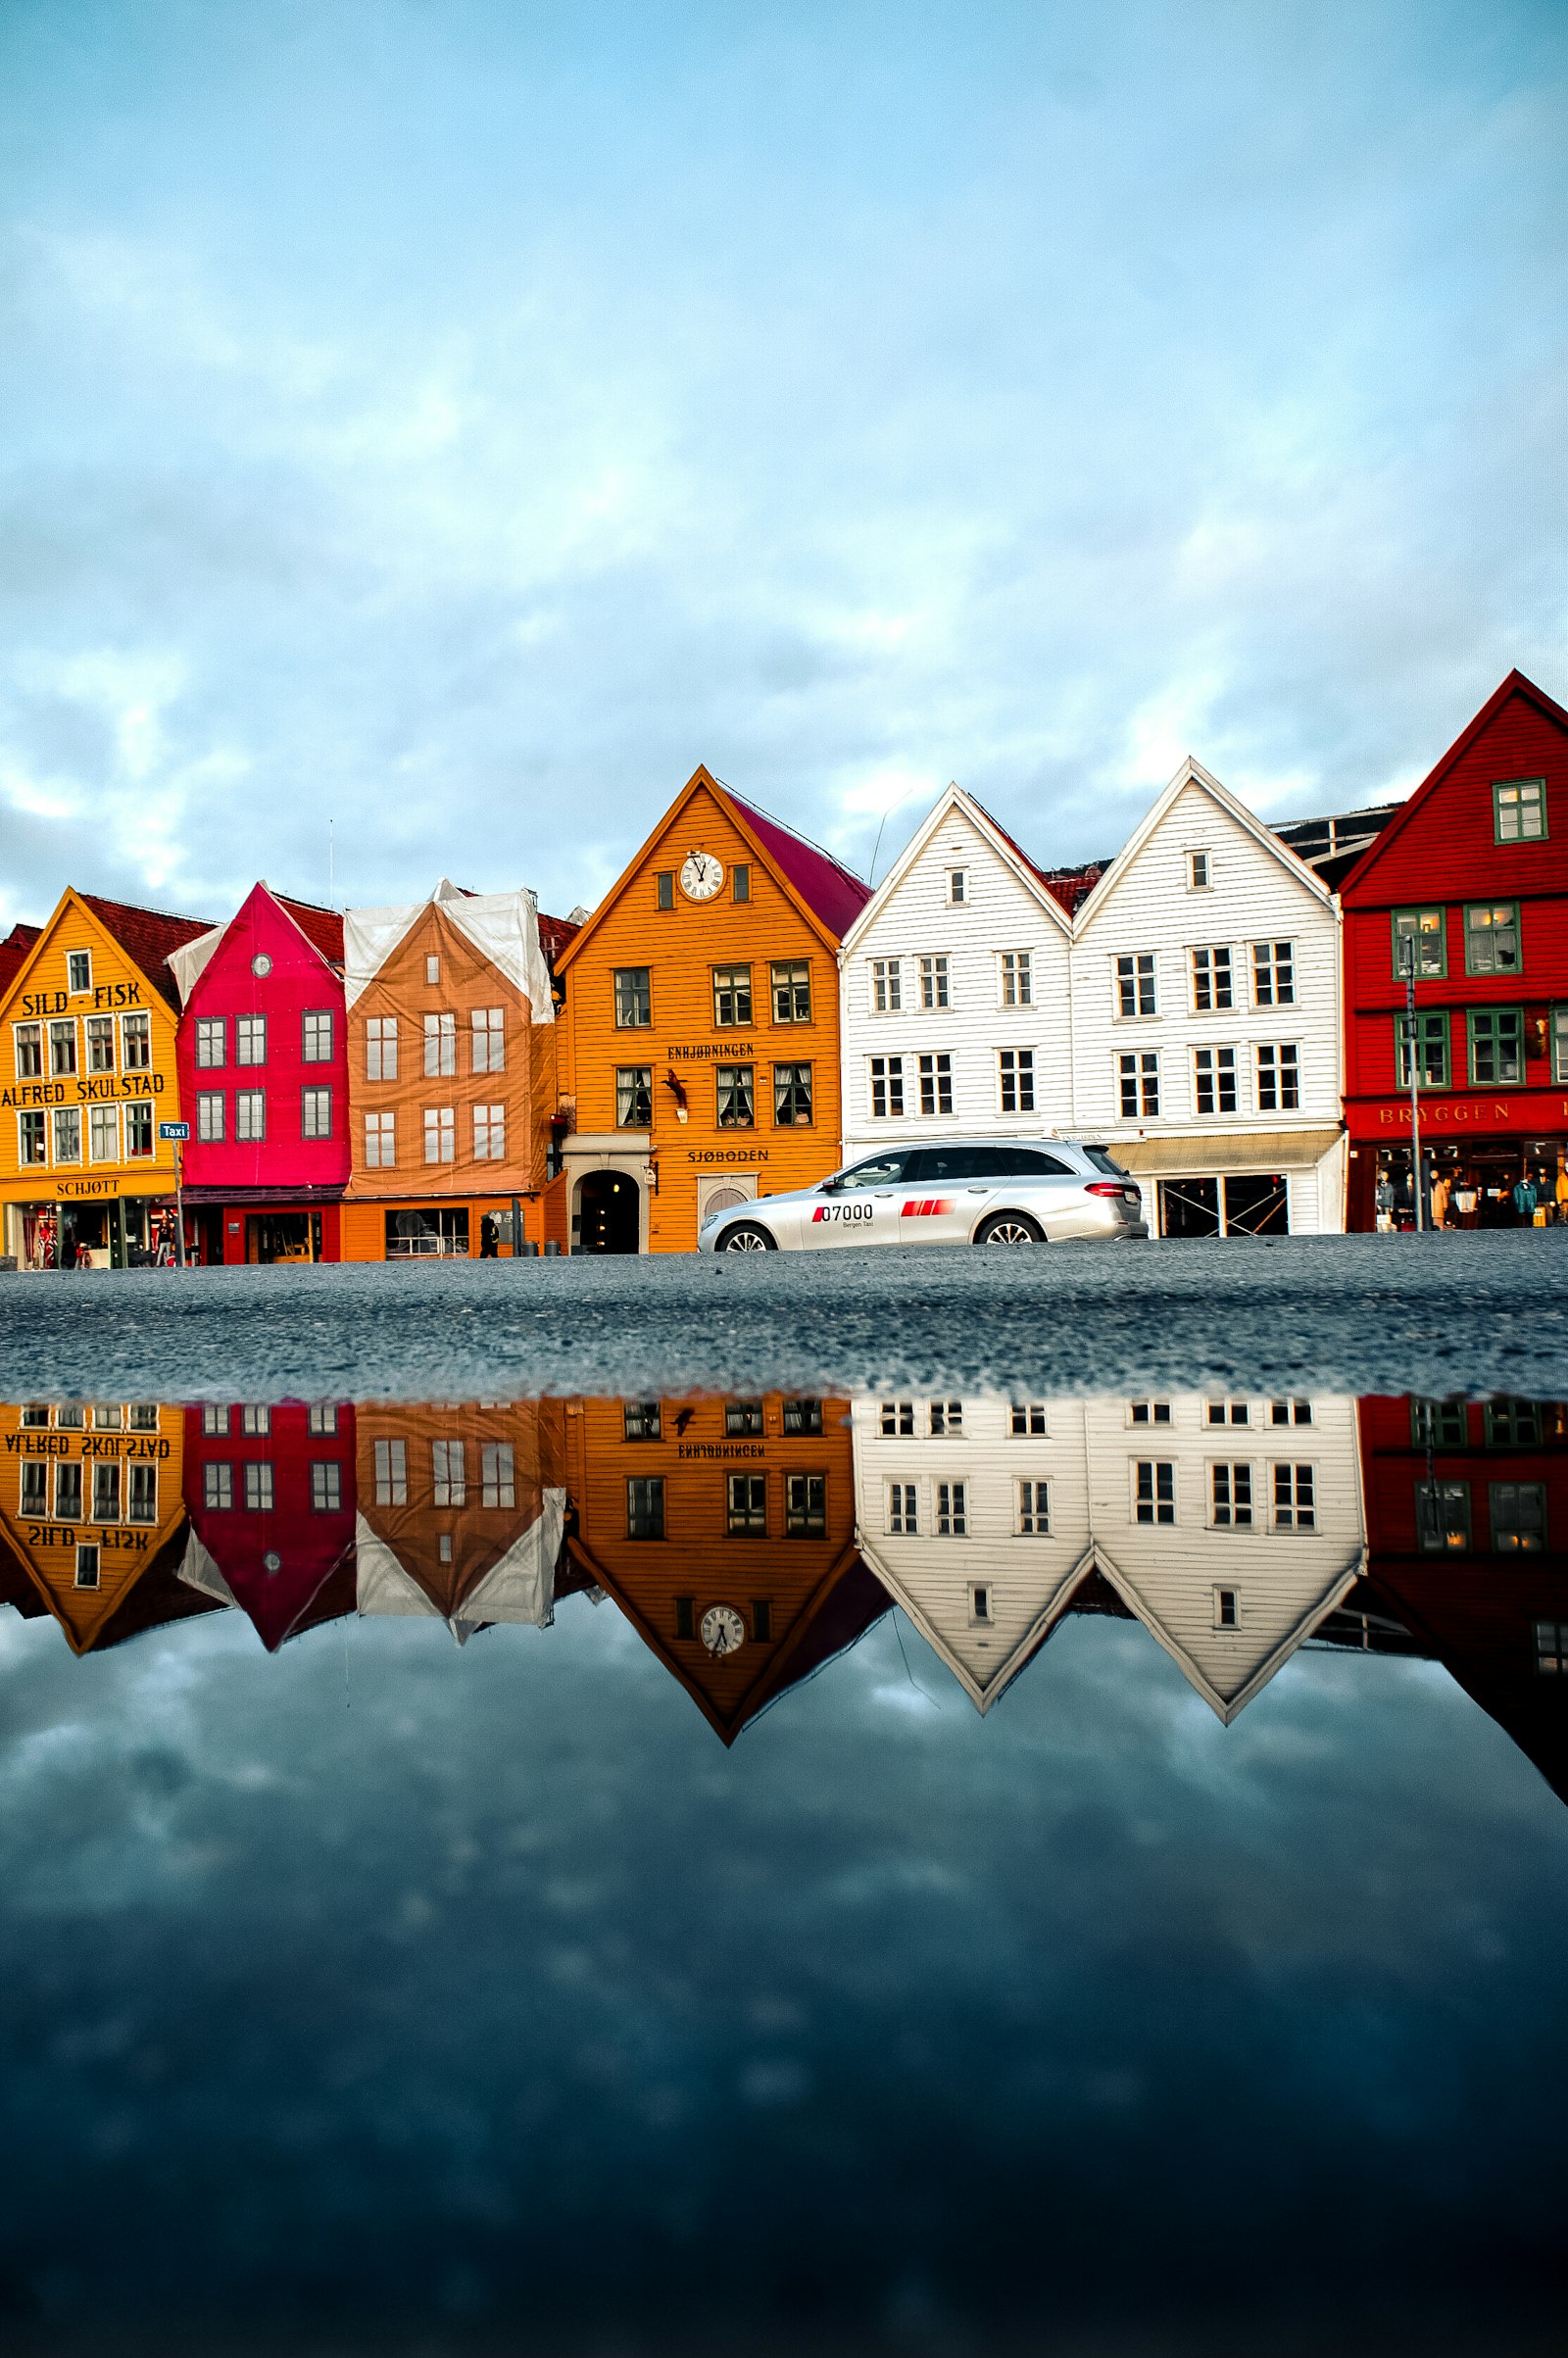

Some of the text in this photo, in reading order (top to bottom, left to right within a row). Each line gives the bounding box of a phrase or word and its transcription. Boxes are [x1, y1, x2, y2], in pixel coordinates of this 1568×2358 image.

[23, 991, 68, 1016] SILD
[95, 982, 140, 1007] FISK
[668, 1043, 754, 1059] ENHJØRNINGEN
[1, 1074, 164, 1106] ALFRED SKULSTAD
[1379, 1104, 1509, 1124] BRYGGEN
[163, 1125, 185, 1137] Taxi
[688, 1150, 768, 1162] SJØBODEN
[57, 1179, 120, 1196] SCHJØTT
[822, 1204, 872, 1222] 07000
